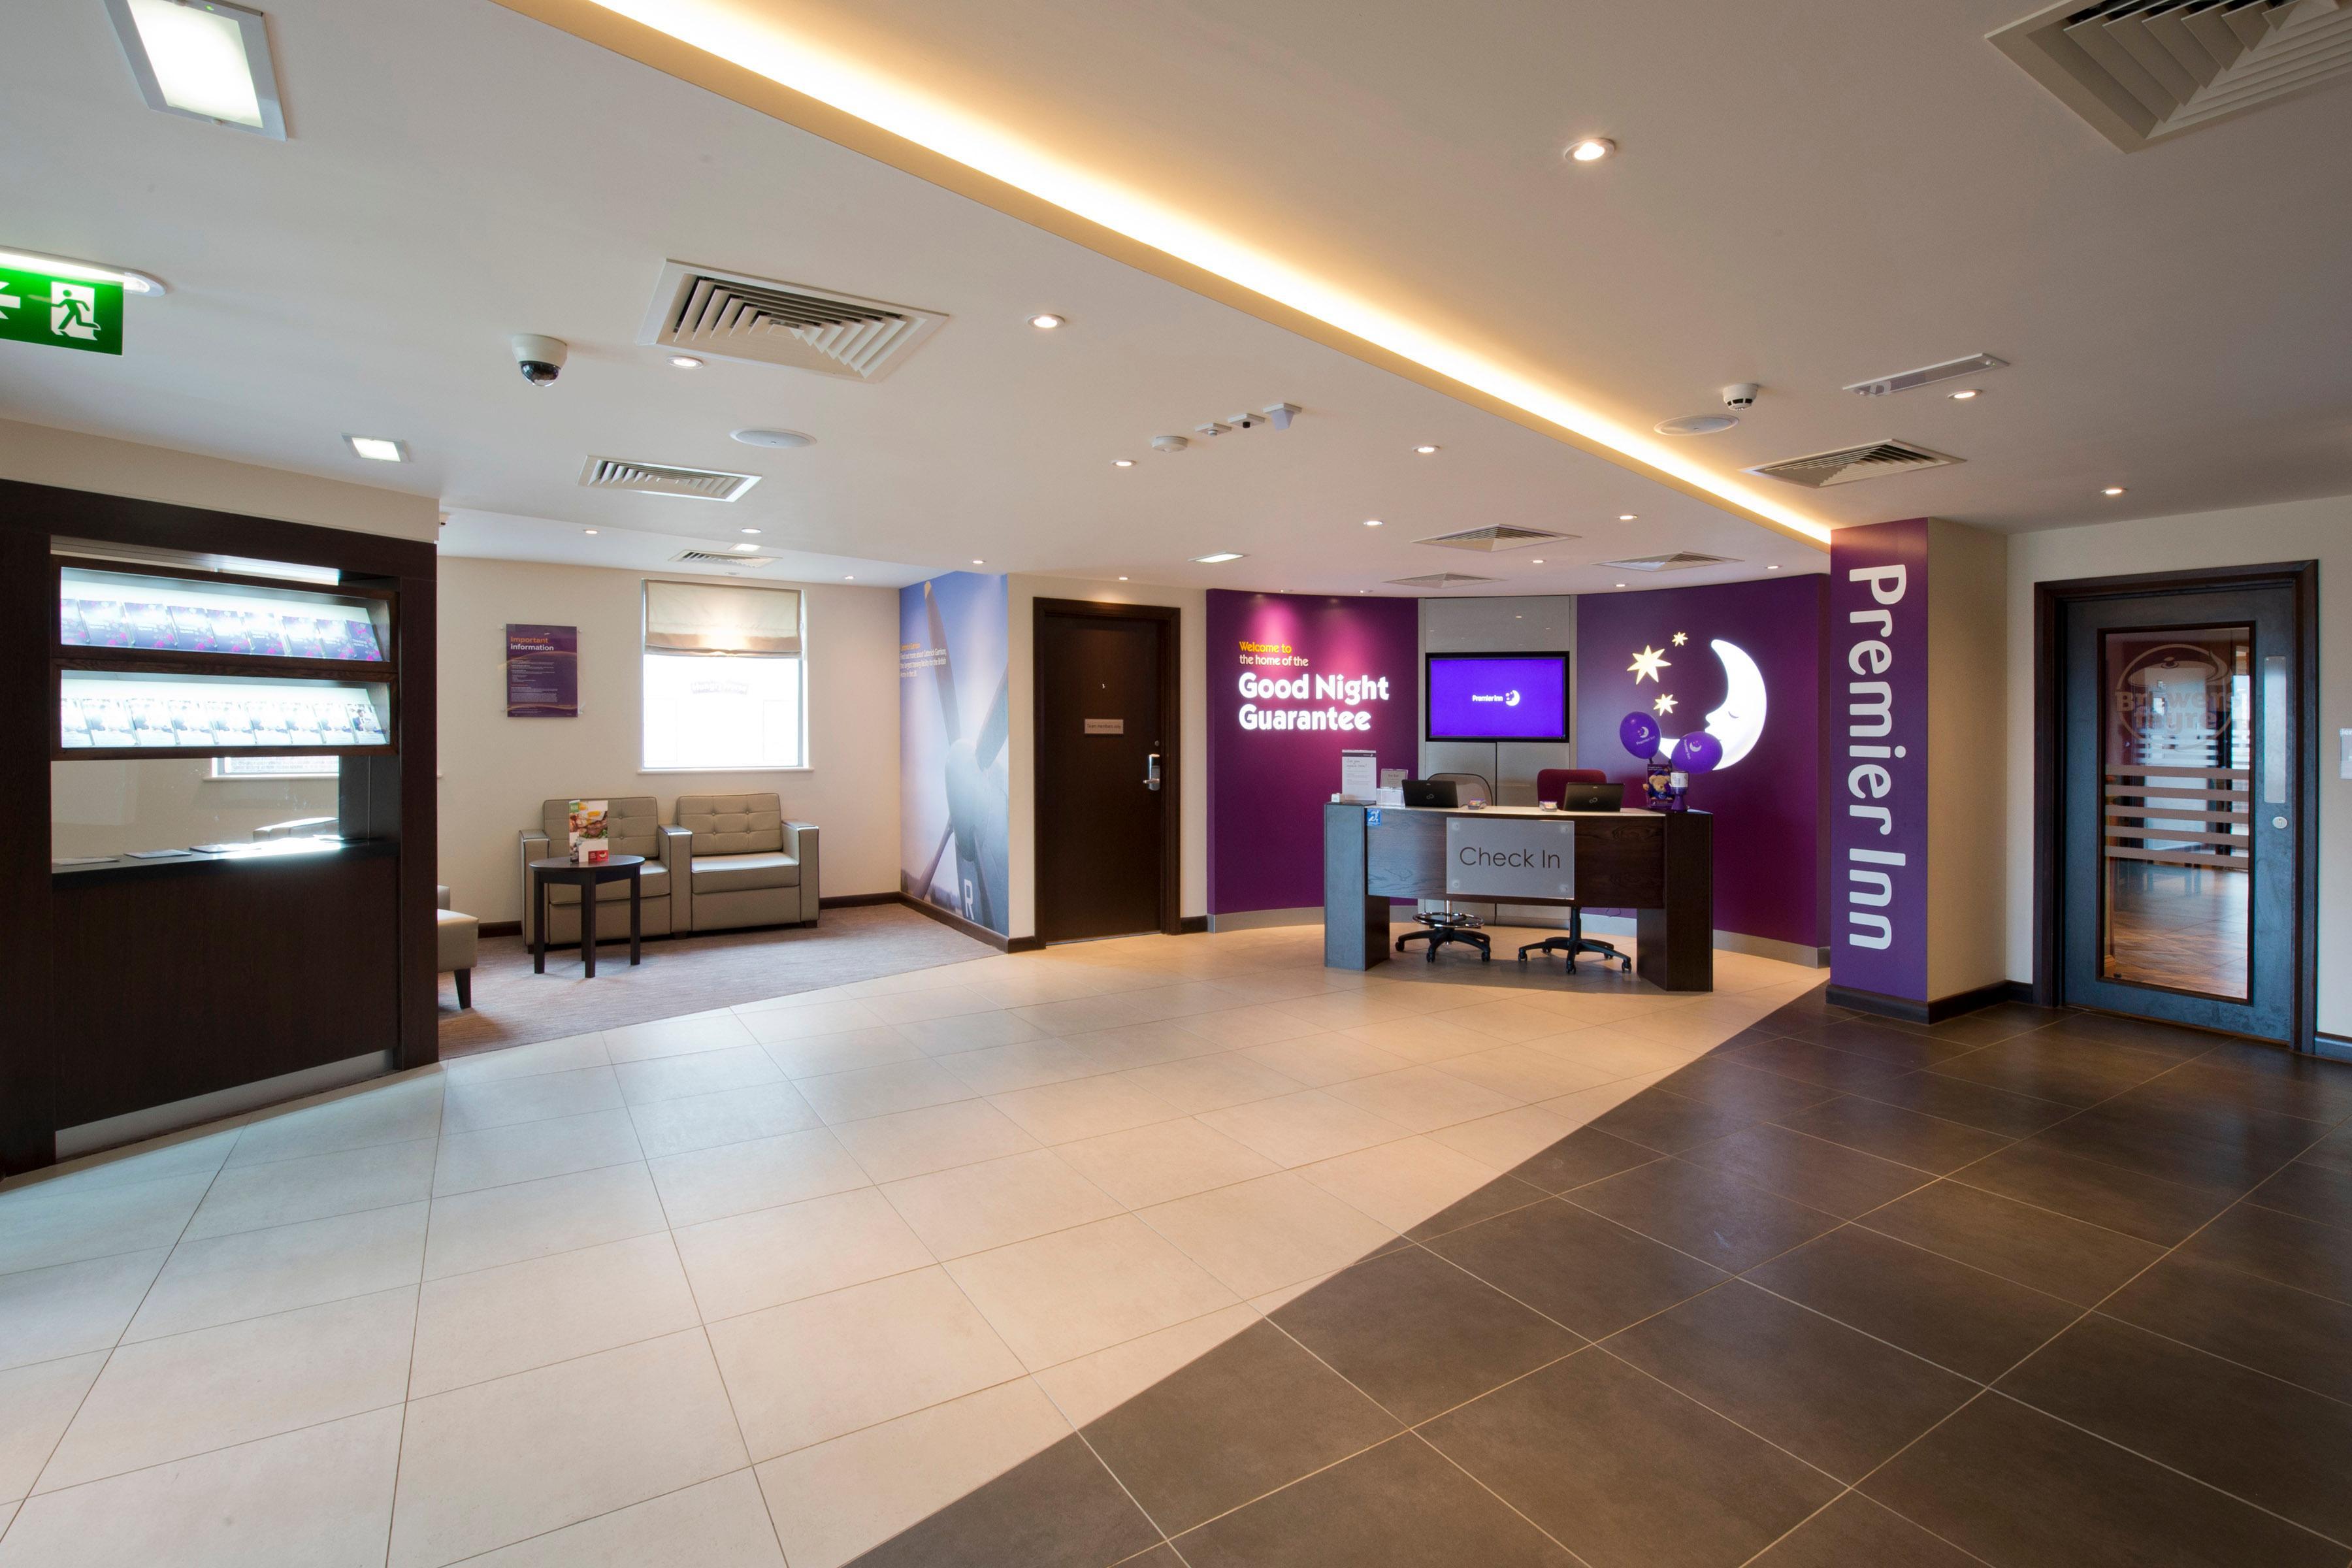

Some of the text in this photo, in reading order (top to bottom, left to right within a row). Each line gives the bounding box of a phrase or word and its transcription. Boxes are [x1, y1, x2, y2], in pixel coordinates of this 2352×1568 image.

[1239, 642, 1292, 653] Welcome to
[1239, 655, 1309, 666] the home of the
[1239, 672, 1390, 706] Good Night
[1239, 704, 1371, 730] Guarantee
[1848, 564, 1906, 949] Premier Inn
[1460, 847, 1560, 868] Check In
[964, 879, 974, 921] R
